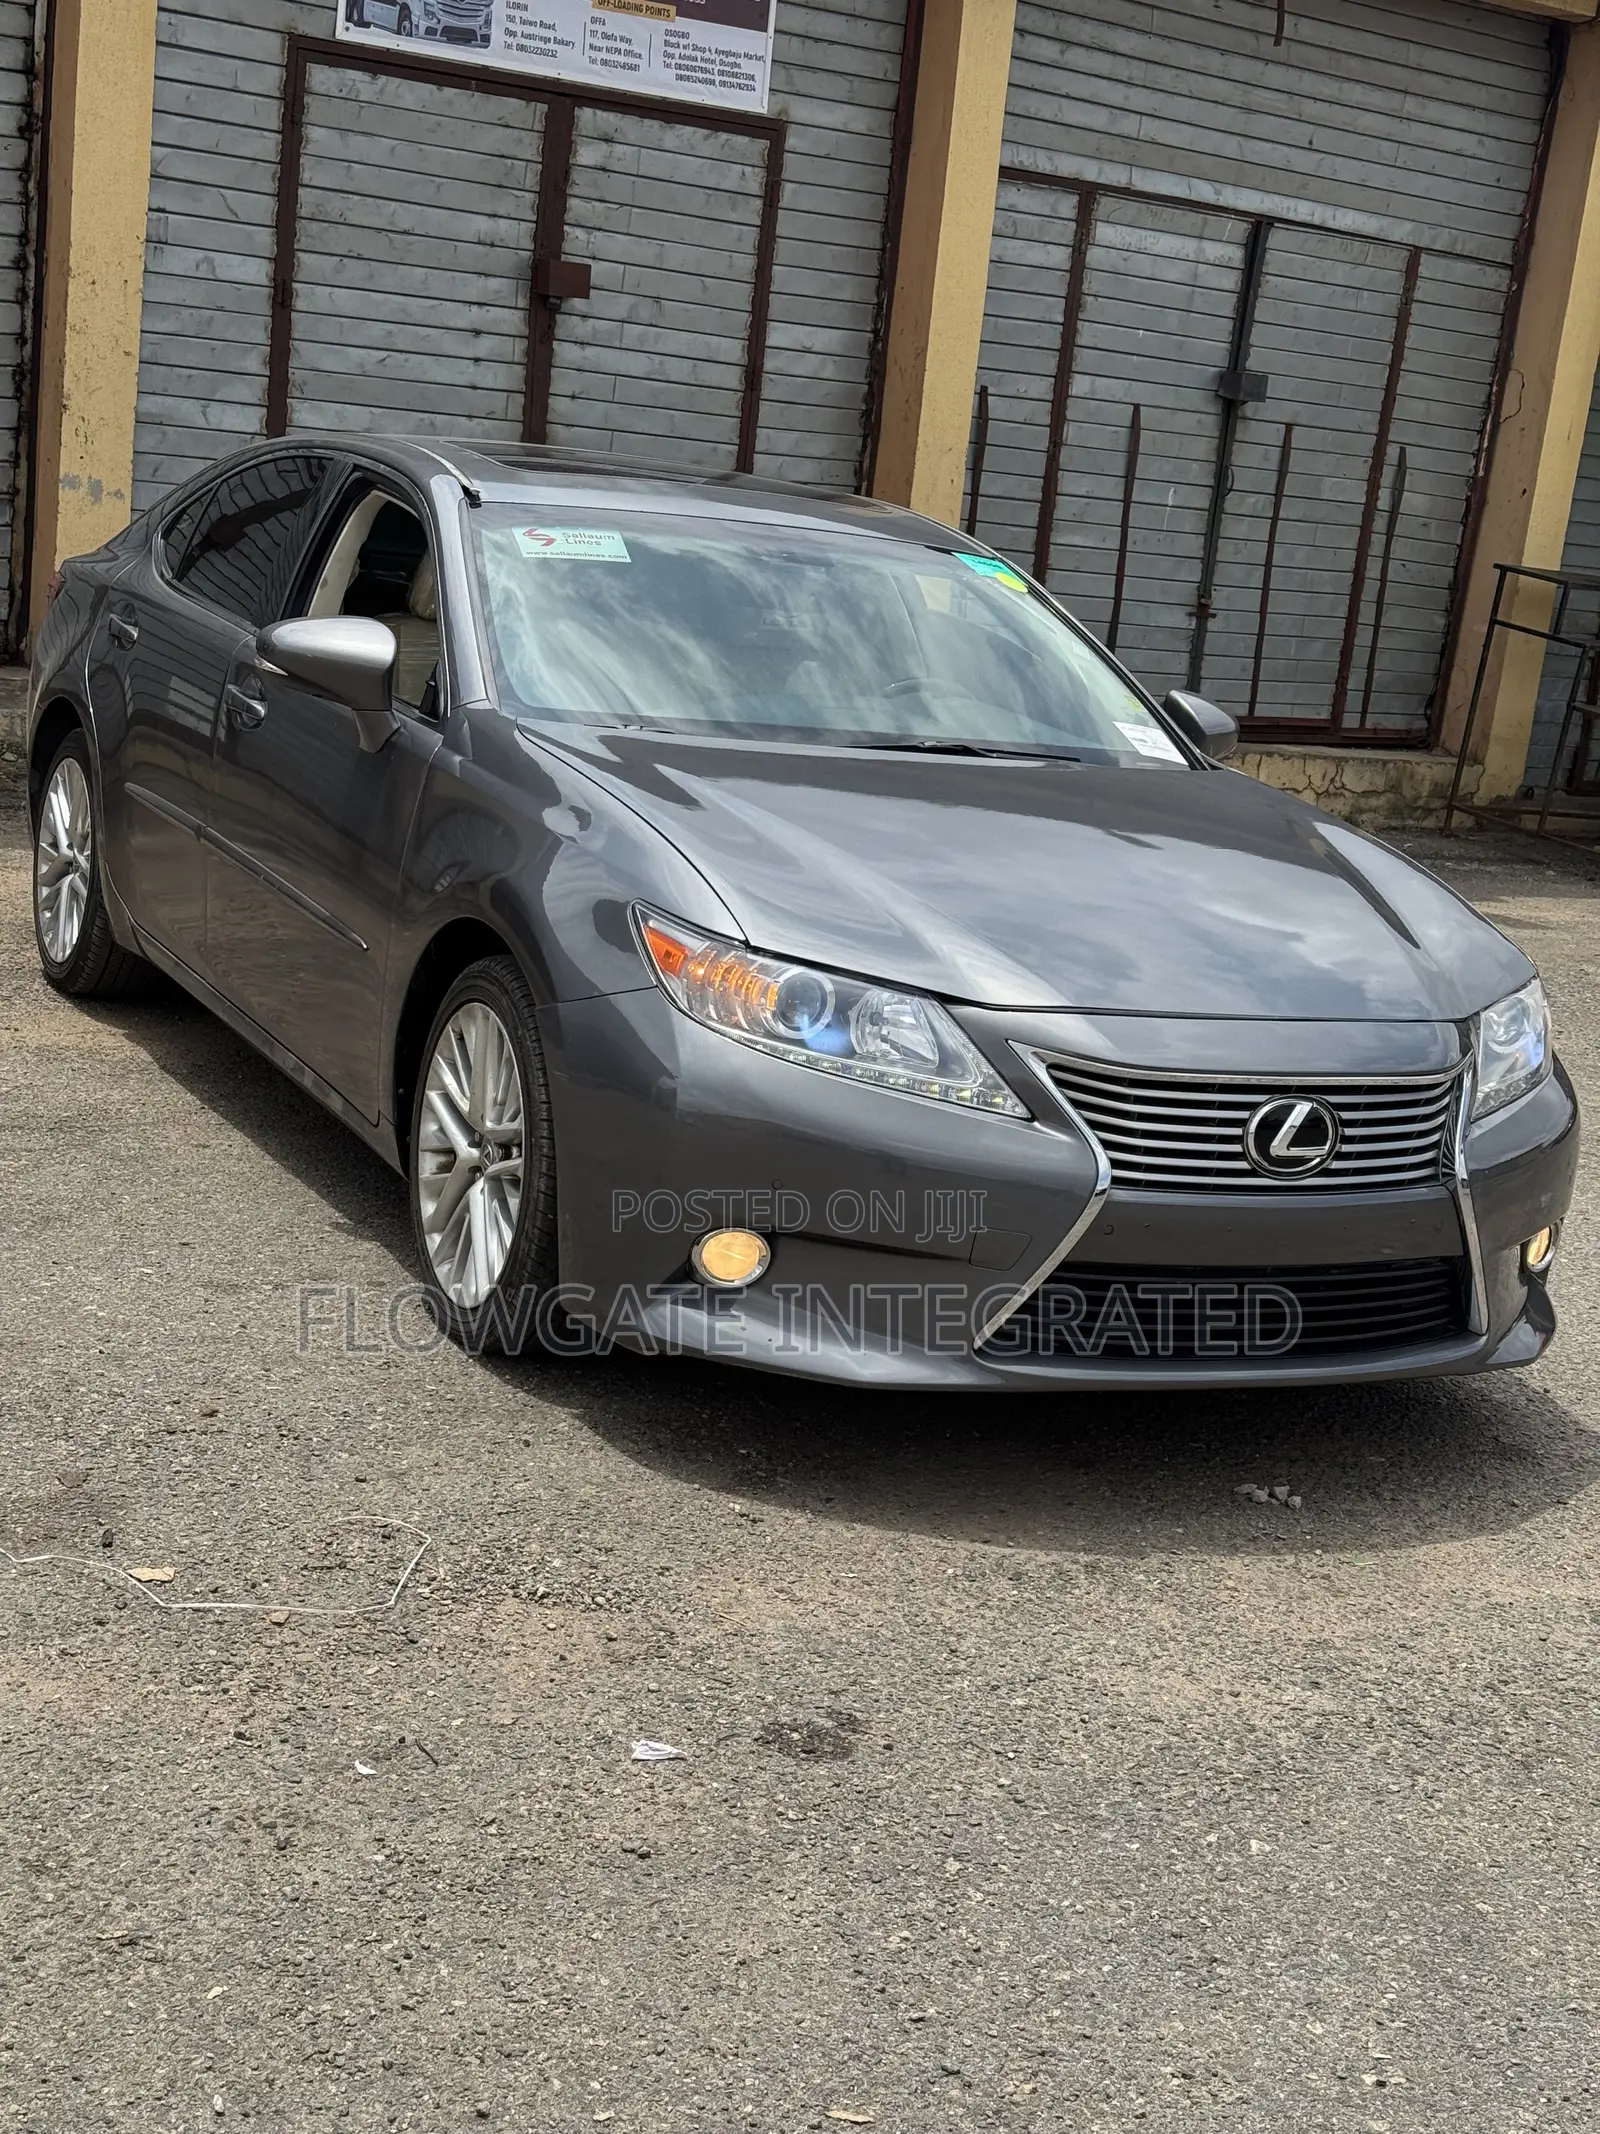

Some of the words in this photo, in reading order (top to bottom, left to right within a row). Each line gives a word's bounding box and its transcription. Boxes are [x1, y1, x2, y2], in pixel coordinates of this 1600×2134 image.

[505, 0, 529, 12] ILORIN
[645, 6, 671, 18] POINTS
[519, 16, 538, 28] Taiwo
[539, 20, 557, 32] Road,
[590, 16, 606, 26] OFFA
[504, 27, 519, 39] Opp.
[601, 31, 618, 42] Olofa
[664, 28, 690, 40] OSOGBO
[503, 41, 514, 51] Tel:
[588, 43, 604, 53] Near
[605, 46, 622, 56] NEPA
[623, 49, 644, 60] Office.
[663, 39, 680, 50] Block
[691, 43, 707, 55] Shop
[743, 52, 766, 63] Market,
[588, 56, 599, 66] Tel:
[663, 50, 676, 61] Opp.
[700, 56, 717, 67] Hotel,
[562, 532, 615, 541] Sallaum
[565, 538, 602, 546] Lines
[525, 551, 628, 560] www.sallaumlines.com
